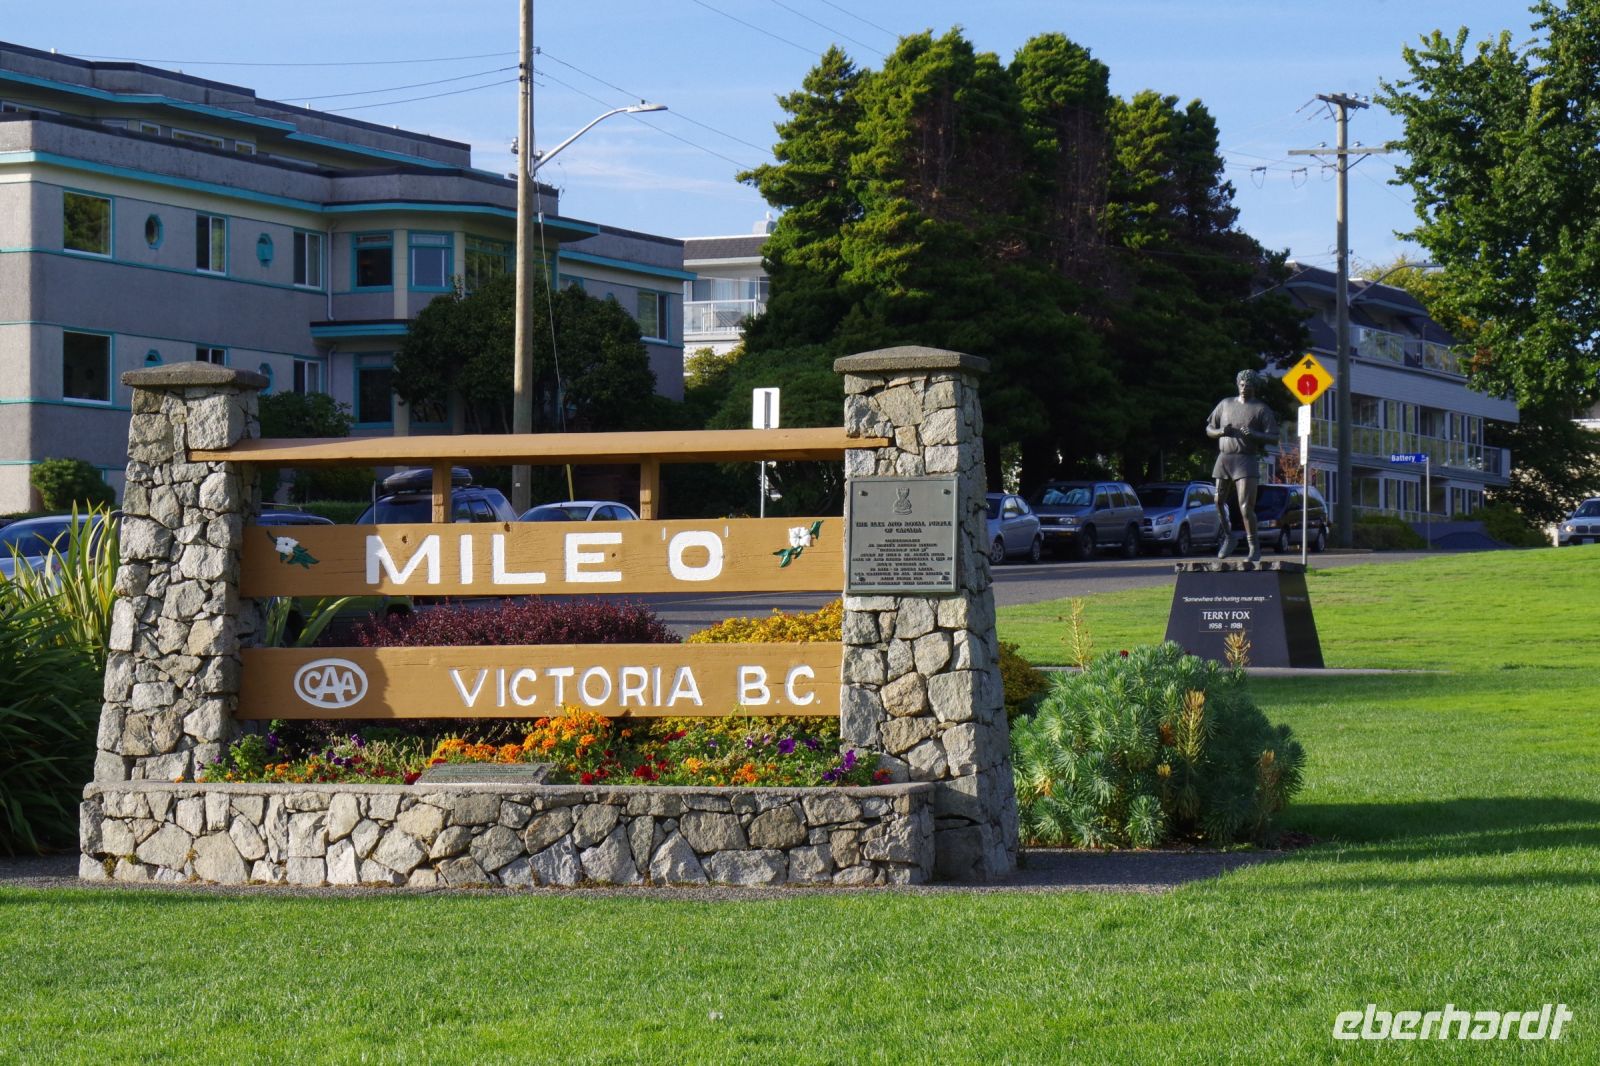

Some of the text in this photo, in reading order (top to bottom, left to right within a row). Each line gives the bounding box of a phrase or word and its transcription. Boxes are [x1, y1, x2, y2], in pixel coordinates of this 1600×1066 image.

[1391, 455, 1416, 463] Battery
[365, 532, 622, 584] MILE
[1202, 611, 1250, 620] TERRY FOX
[303, 666, 357, 704] CAA
[450, 666, 703, 707] VICTORIA
